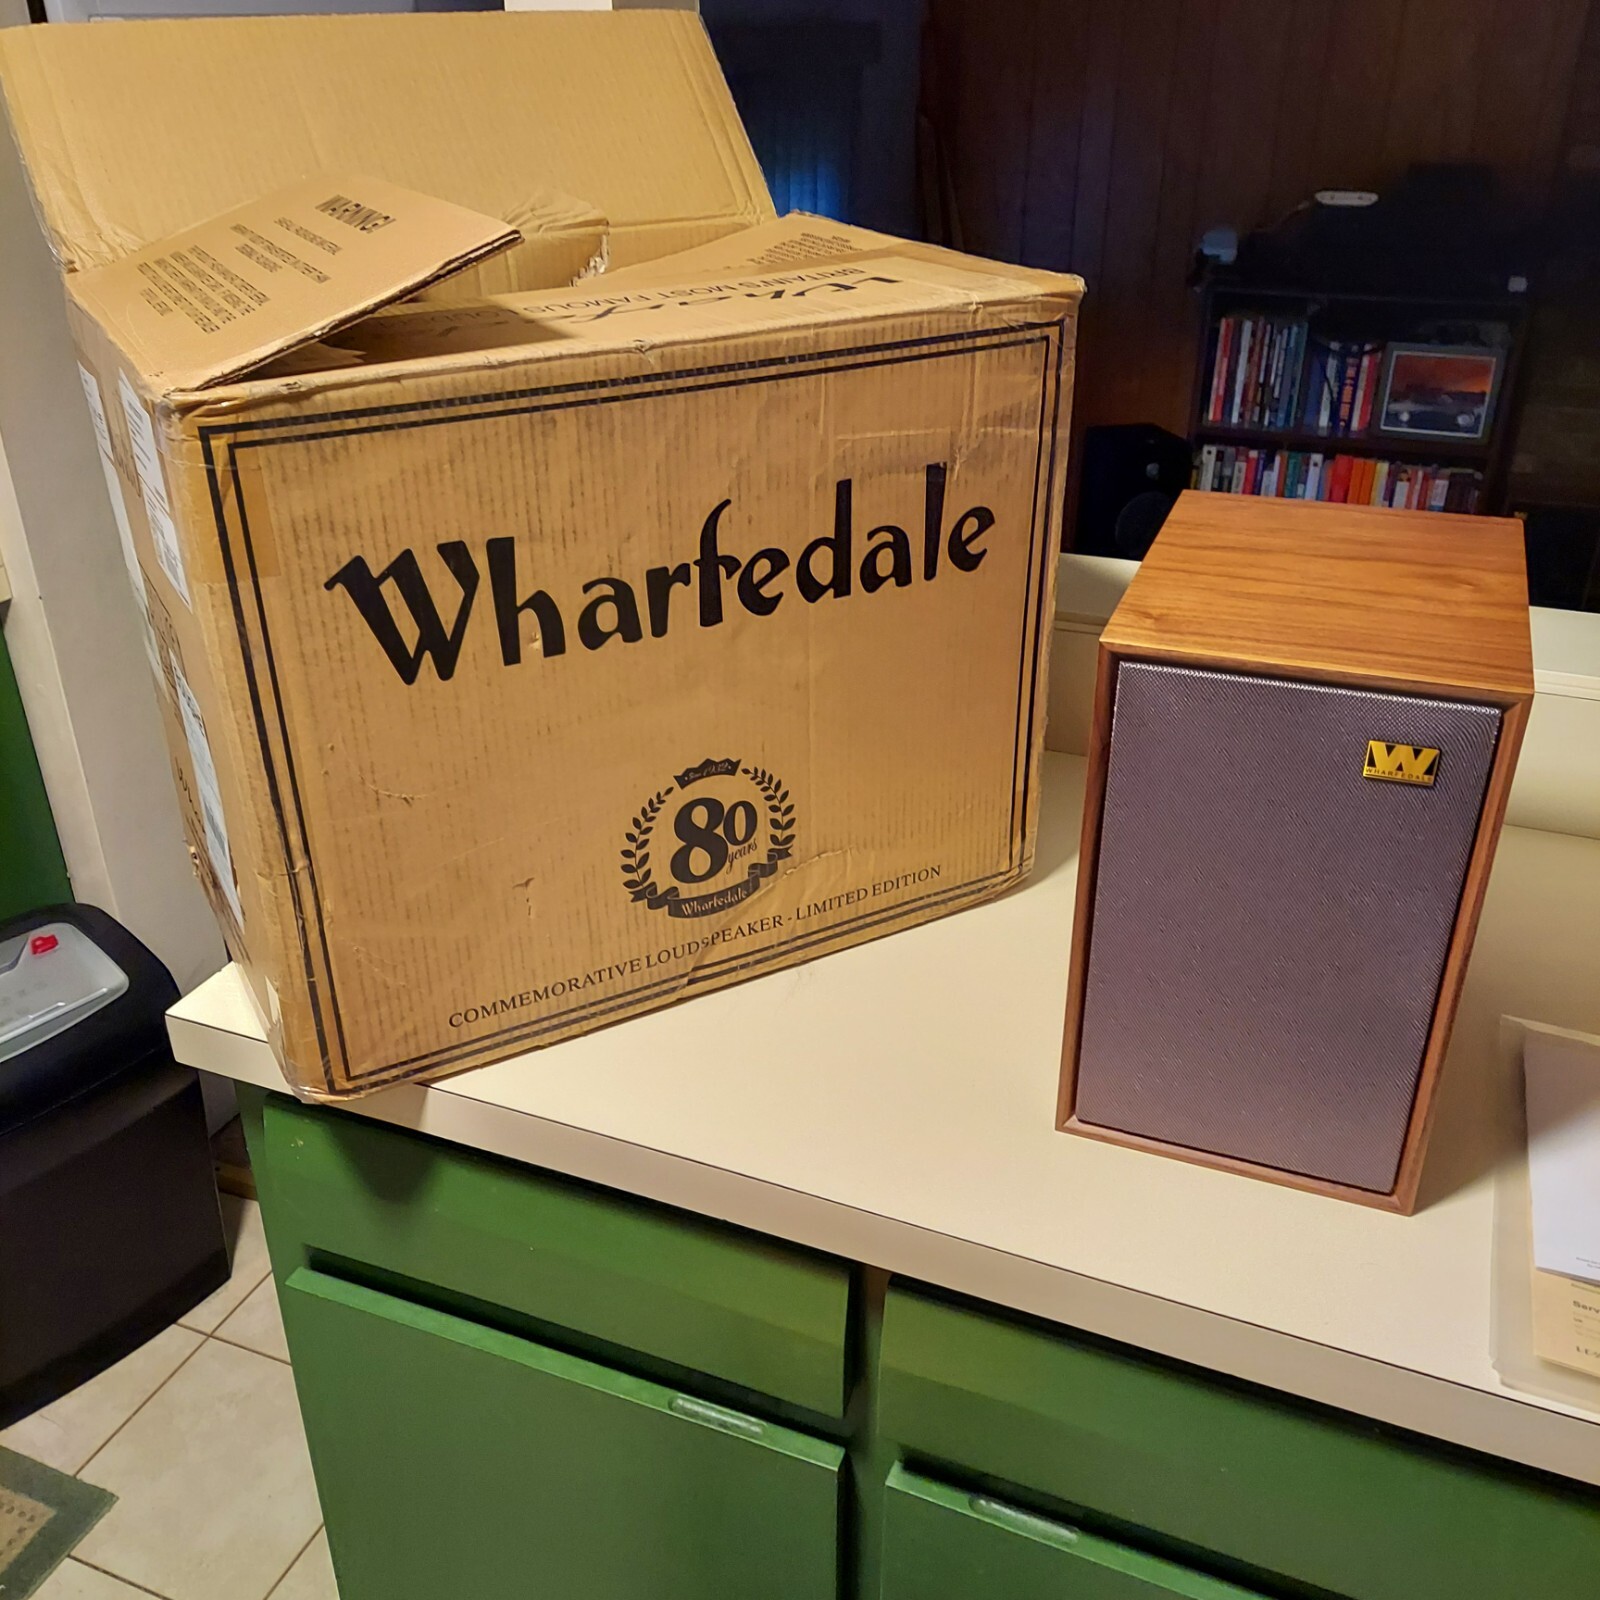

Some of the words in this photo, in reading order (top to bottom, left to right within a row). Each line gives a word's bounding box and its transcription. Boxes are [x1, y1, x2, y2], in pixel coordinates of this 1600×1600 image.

[657, 285, 738, 301] MOST
[738, 267, 866, 290] BRITAIN'S
[523, 295, 651, 314] FAMOUS
[324, 461, 996, 686] Wharfedale
[670, 797, 758, 884] 80
[726, 838, 758, 875] years
[681, 887, 748, 917] Wharfedale
[448, 958, 642, 1028] COMMEMORATIVE
[645, 914, 785, 969] LOUDSPEAKER
[796, 888, 868, 920] LIMITED
[871, 864, 942, 898] EDITION
